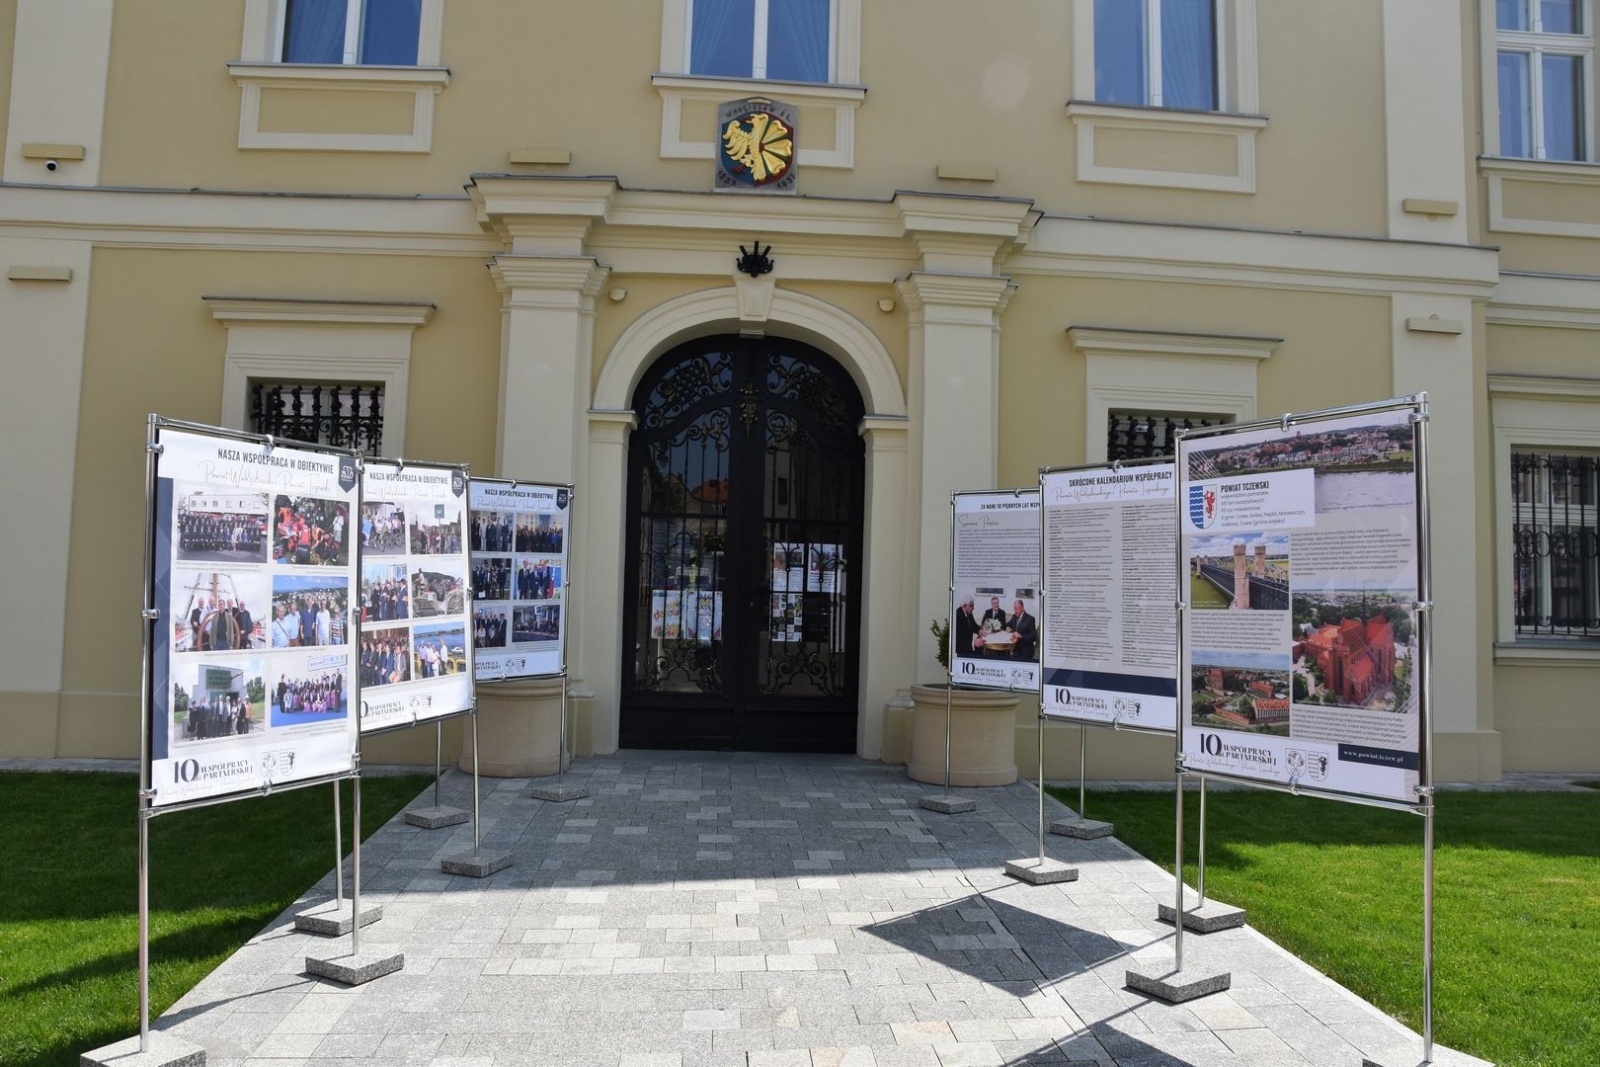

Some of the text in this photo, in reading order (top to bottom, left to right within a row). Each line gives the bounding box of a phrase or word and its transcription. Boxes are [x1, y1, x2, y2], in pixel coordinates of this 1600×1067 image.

[217, 448, 241, 462] NASZA
[242, 451, 289, 468] WSPÓŁPRACA
[290, 459, 296, 469] W
[297, 460, 334, 475] OBIEKTYWIE
[369, 471, 386, 482] NASZA
[1069, 471, 1173, 488] SKRÓCONE KALENDARIUM WSPÓŁPRACY
[1220, 481, 1270, 493] POWIAT TCZEWSKI
[962, 661, 976, 675] 10
[1055, 688, 1071, 704] 10
[1200, 733, 1222, 756] 10
[1225, 752, 1277, 767] PARTNERSKIEJ
[174, 758, 200, 783] 10
[203, 765, 253, 780] PARTNERSKIEJ
